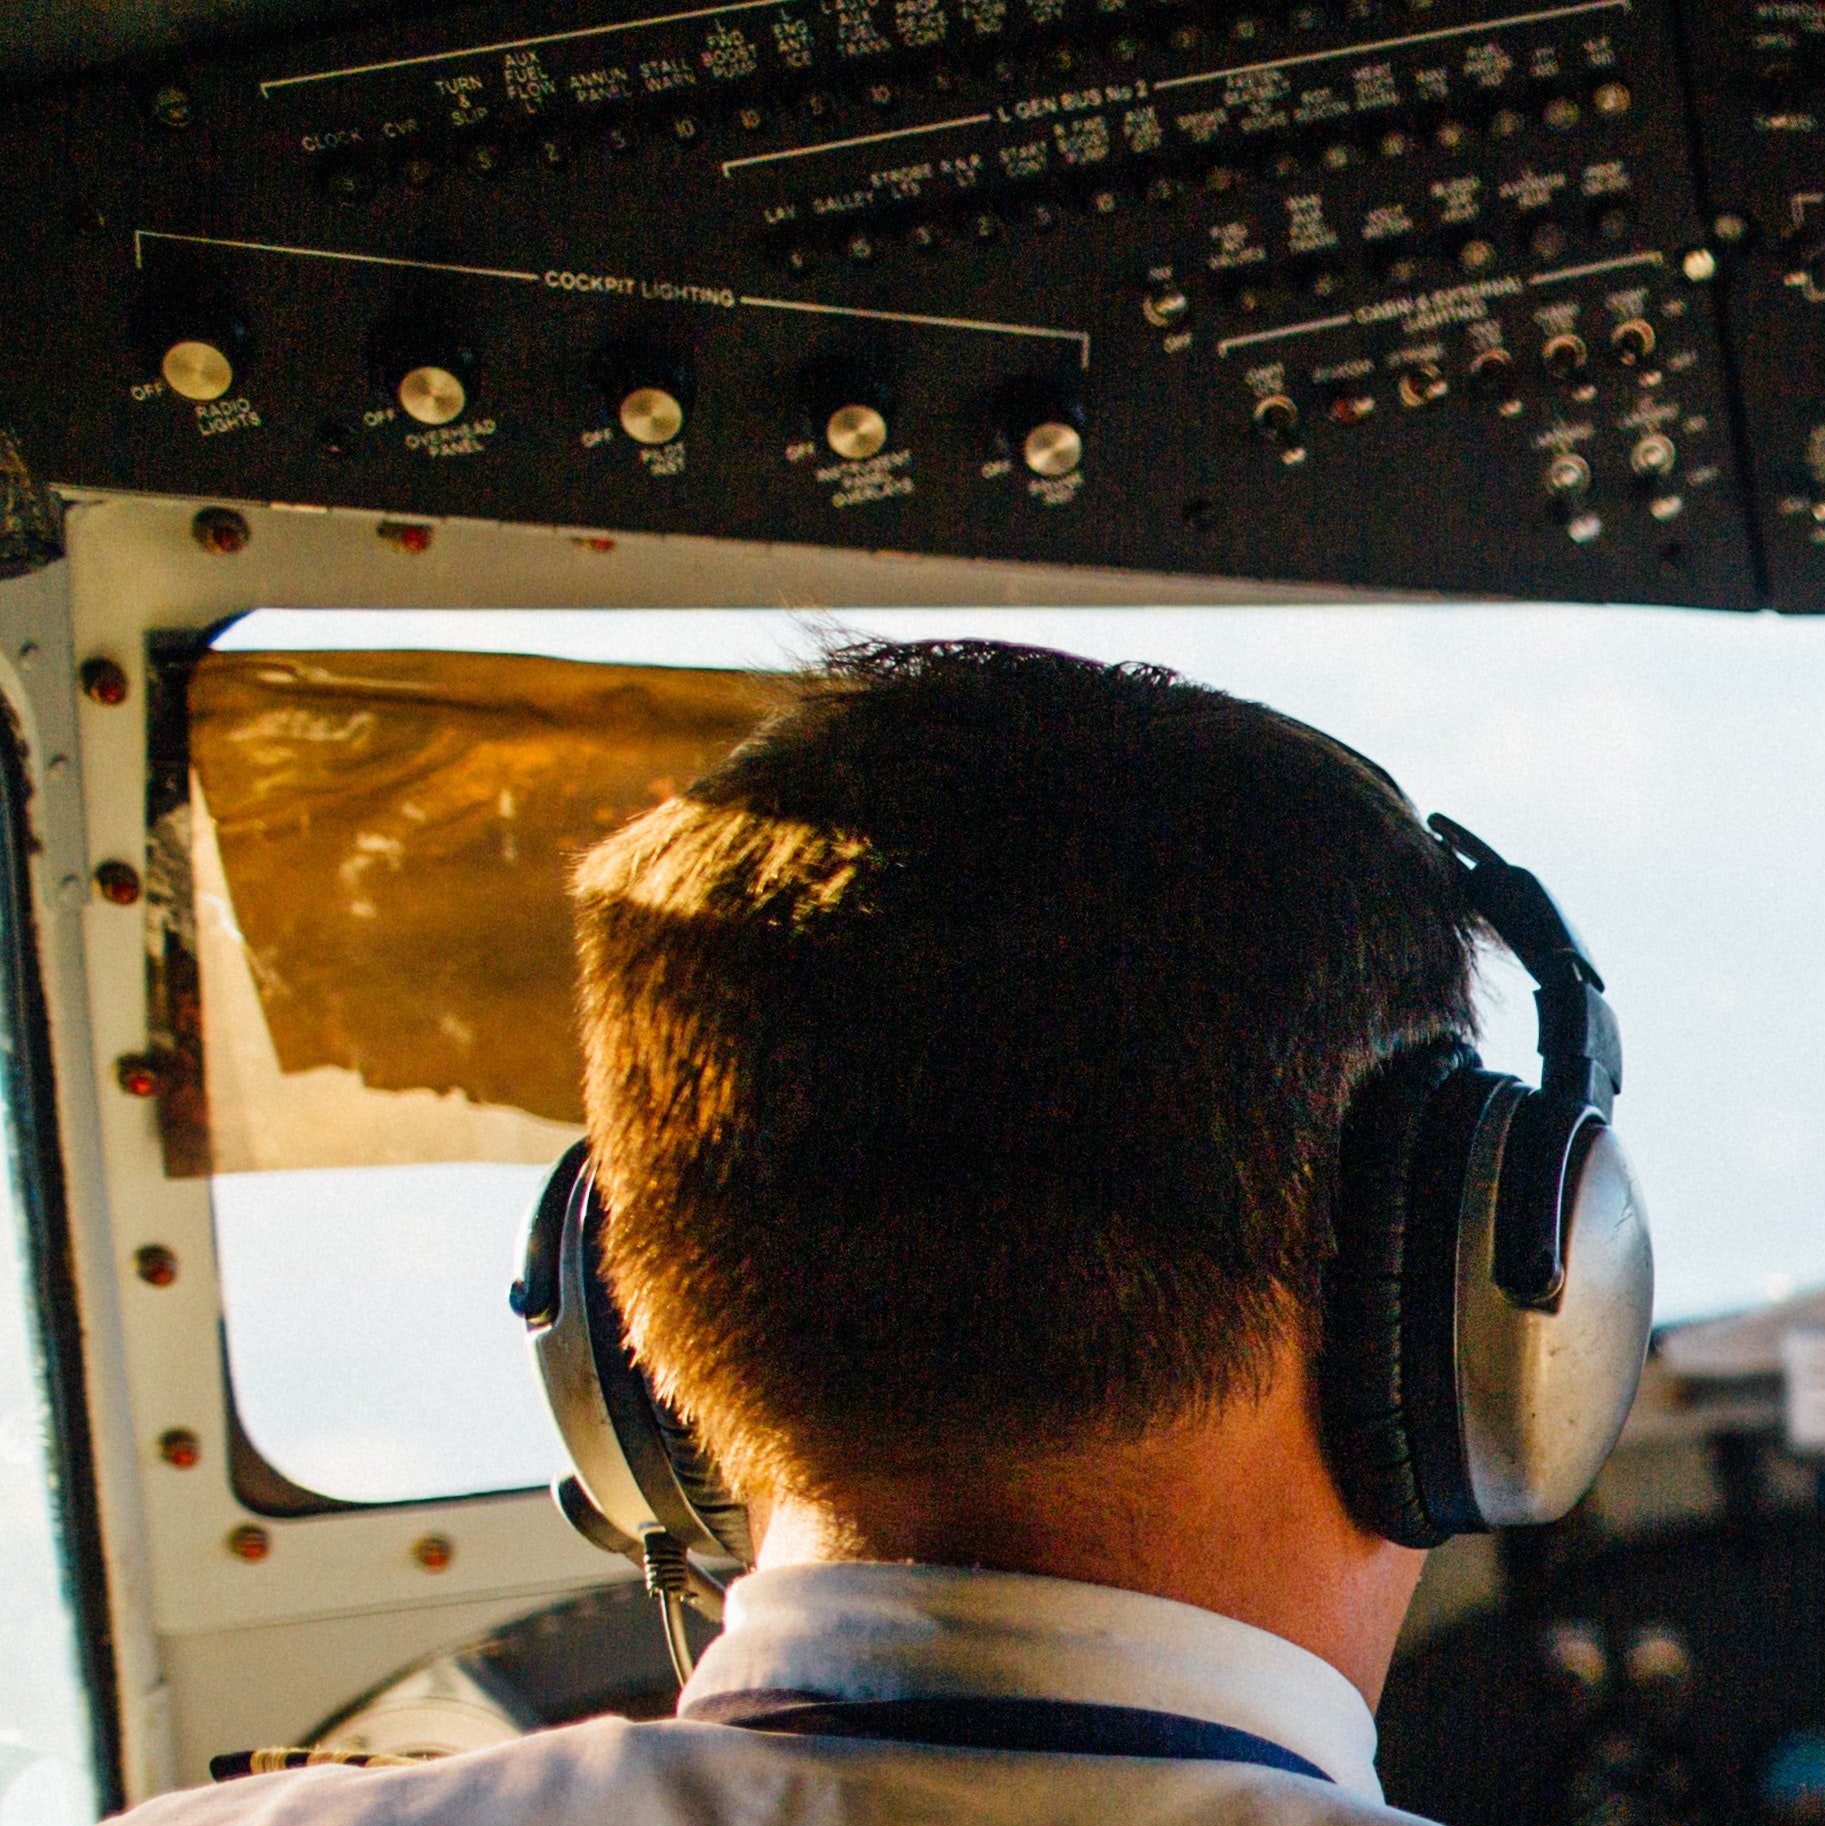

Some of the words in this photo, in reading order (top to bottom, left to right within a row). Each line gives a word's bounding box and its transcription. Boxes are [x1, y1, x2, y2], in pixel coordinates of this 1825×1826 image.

[772, 19, 809, 39] ENG
[504, 51, 540, 69] AUX
[701, 44, 757, 68] BOOST
[504, 66, 548, 84] FUEL
[569, 68, 628, 90] ANNUN
[640, 58, 691, 79] STALL
[435, 75, 484, 96] TURN
[507, 80, 557, 99] FLOW
[646, 72, 696, 92] WARN
[576, 84, 631, 103] PANEL
[997, 106, 1012, 124] L
[1015, 95, 1059, 120] GEN
[1060, 86, 1104, 112] BUS
[450, 106, 489, 127] SLIP
[302, 129, 362, 151] CLOCK
[544, 269, 636, 297] COCKPIT
[641, 280, 736, 309] LIGHTING
[130, 377, 164, 402] OFF
[195, 397, 251, 422] RADIO
[362, 406, 396, 427] OFF
[199, 408, 263, 438] LIGHTS
[404, 417, 497, 451] OVERHEAD
[580, 426, 613, 450] OFF
[785, 440, 816, 463] OFF
[980, 457, 1013, 480] OFF
